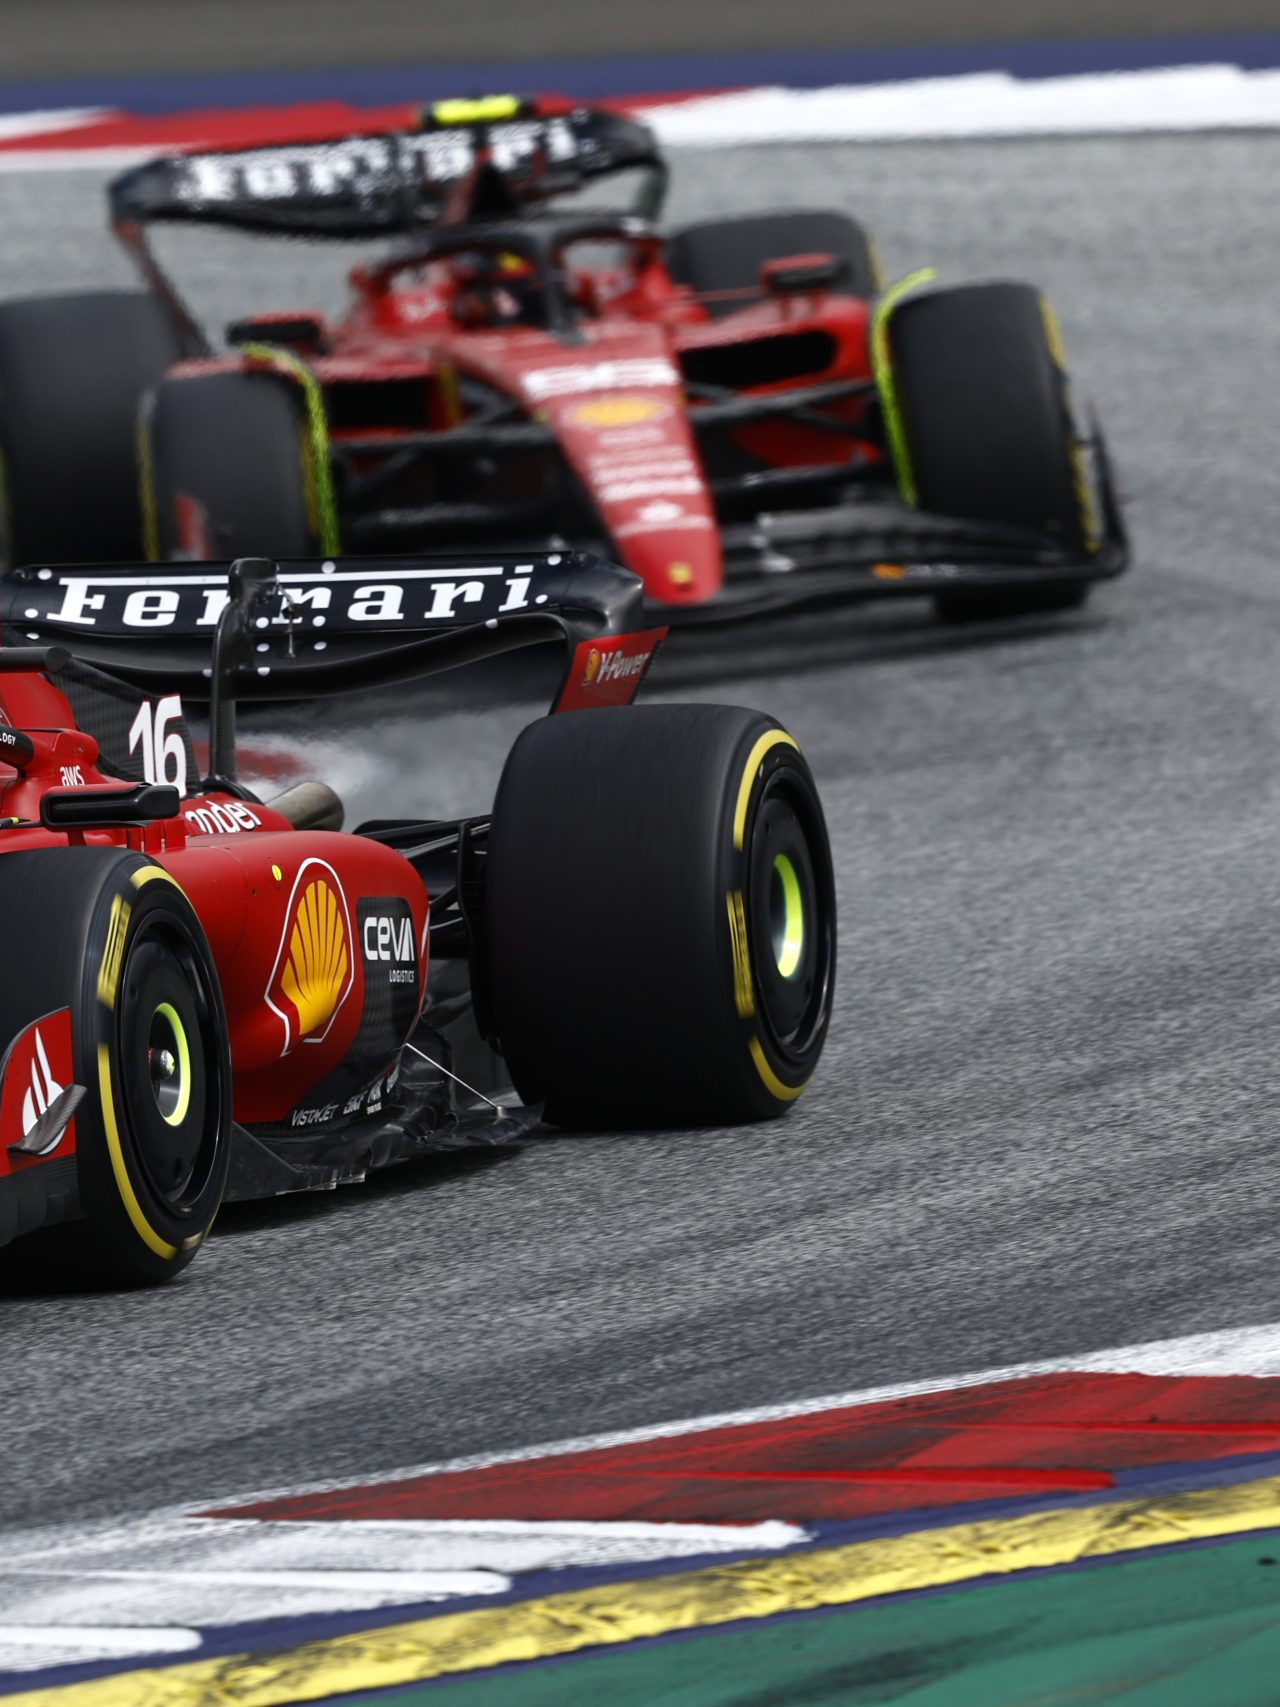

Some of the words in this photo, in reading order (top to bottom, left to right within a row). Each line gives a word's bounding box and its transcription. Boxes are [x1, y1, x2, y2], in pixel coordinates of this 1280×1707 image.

[46, 564, 535, 628] Ferrari
[59, 765, 86, 786] aws
[128, 694, 187, 799] 16
